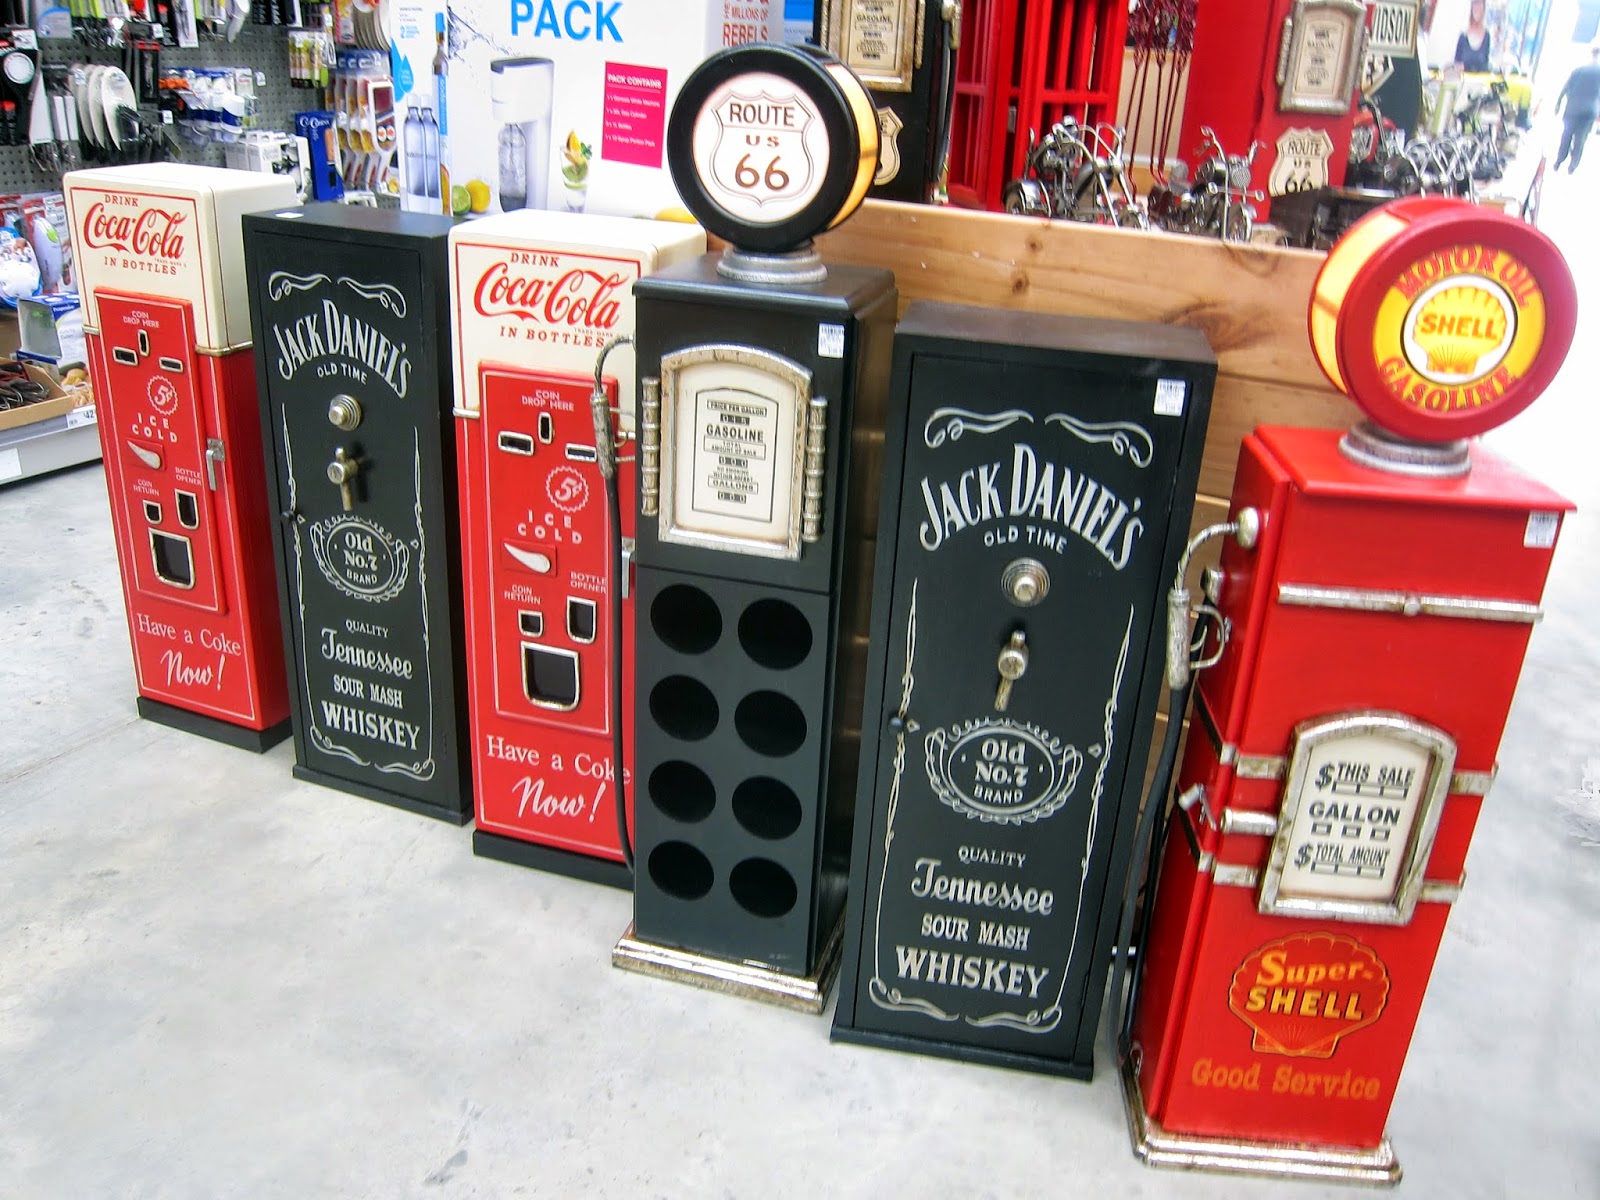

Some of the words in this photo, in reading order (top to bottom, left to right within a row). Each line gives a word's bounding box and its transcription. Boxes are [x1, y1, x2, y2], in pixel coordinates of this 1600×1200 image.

[510, 0, 624, 43] PACK
[1374, 6, 1411, 45] IDSON
[722, 22, 768, 47] REBELS
[607, 73, 627, 85] PACK
[627, 76, 663, 90] CONTAINS
[729, 103, 795, 128] ROUTE
[1287, 139, 1321, 156] ROUTE
[735, 153, 790, 191] 66
[104, 194, 139, 207] DRINK
[104, 256, 117, 267] IN
[122, 257, 177, 275] BOTTLES
[510, 252, 561, 268] DRINK
[1394, 246, 1499, 300] MOTOR
[1499, 259, 1539, 309] OIL
[123, 316, 140, 325] DROP
[142, 319, 160, 328] HERE
[131, 310, 149, 320] COIN
[1420, 313, 1498, 340] SHELL
[500, 326, 519, 338] IN
[526, 329, 606, 348] BOTTLES
[273, 313, 327, 380] JACK
[321, 299, 413, 399] DANIEL'S
[316, 362, 338, 378] OLD
[340, 363, 368, 386] TIME
[1379, 357, 1515, 413] GASOLINE
[521, 395, 546, 407] DROP
[550, 400, 574, 412] HERE
[535, 389, 560, 400] COIN
[137, 412, 169, 429] ICE
[131, 424, 178, 443] COLD
[706, 423, 764, 443] GASOLINE
[137, 479, 153, 488] COIN
[175, 467, 202, 479] BOTTLE
[175, 474, 202, 486] OPENER
[133, 485, 160, 496] RETURN
[713, 479, 754, 492] GALLONS
[528, 509, 572, 528] ICE
[919, 462, 1004, 551] JACK
[1010, 443, 1144, 571] DANIEL'S
[344, 531, 374, 554] Old
[517, 523, 583, 544] COLD
[983, 525, 1019, 547] OLD
[1026, 525, 1068, 554] TIME
[346, 569, 378, 585] BRAND
[570, 571, 607, 584] BOTTLE
[570, 580, 607, 594] OPENER
[504, 590, 541, 605] RETURN
[511, 584, 533, 595] COIN
[137, 612, 176, 640] Have
[183, 629, 194, 645] a
[200, 628, 242, 656] Coke
[345, 618, 389, 639] QUALITY
[320, 627, 414, 680] Tennessee
[160, 649, 226, 691] Now!
[333, 673, 365, 699] SOUR
[369, 682, 404, 710] MASH
[320, 700, 421, 751] WHISKEY
[486, 734, 540, 766] Have
[551, 753, 564, 772] a
[981, 738, 1027, 764] Old
[1337, 760, 1370, 783] THIS
[1377, 765, 1416, 787] SALE
[512, 775, 607, 823] Now!
[973, 785, 1023, 805] BRAND
[1309, 800, 1400, 826] GALLON
[958, 845, 1027, 868] QUALITY
[1315, 842, 1344, 863] TOTAL
[1349, 846, 1391, 867] AMOUNT
[911, 857, 1054, 916] Tennessee
[921, 912, 970, 942] SOUR
[978, 920, 1031, 951] MASH
[895, 945, 1050, 999] WHISKEY
[1245, 985, 1364, 1021] SHELL
[1191, 1056, 1262, 1091] Good
[1272, 1063, 1381, 1100] Service
